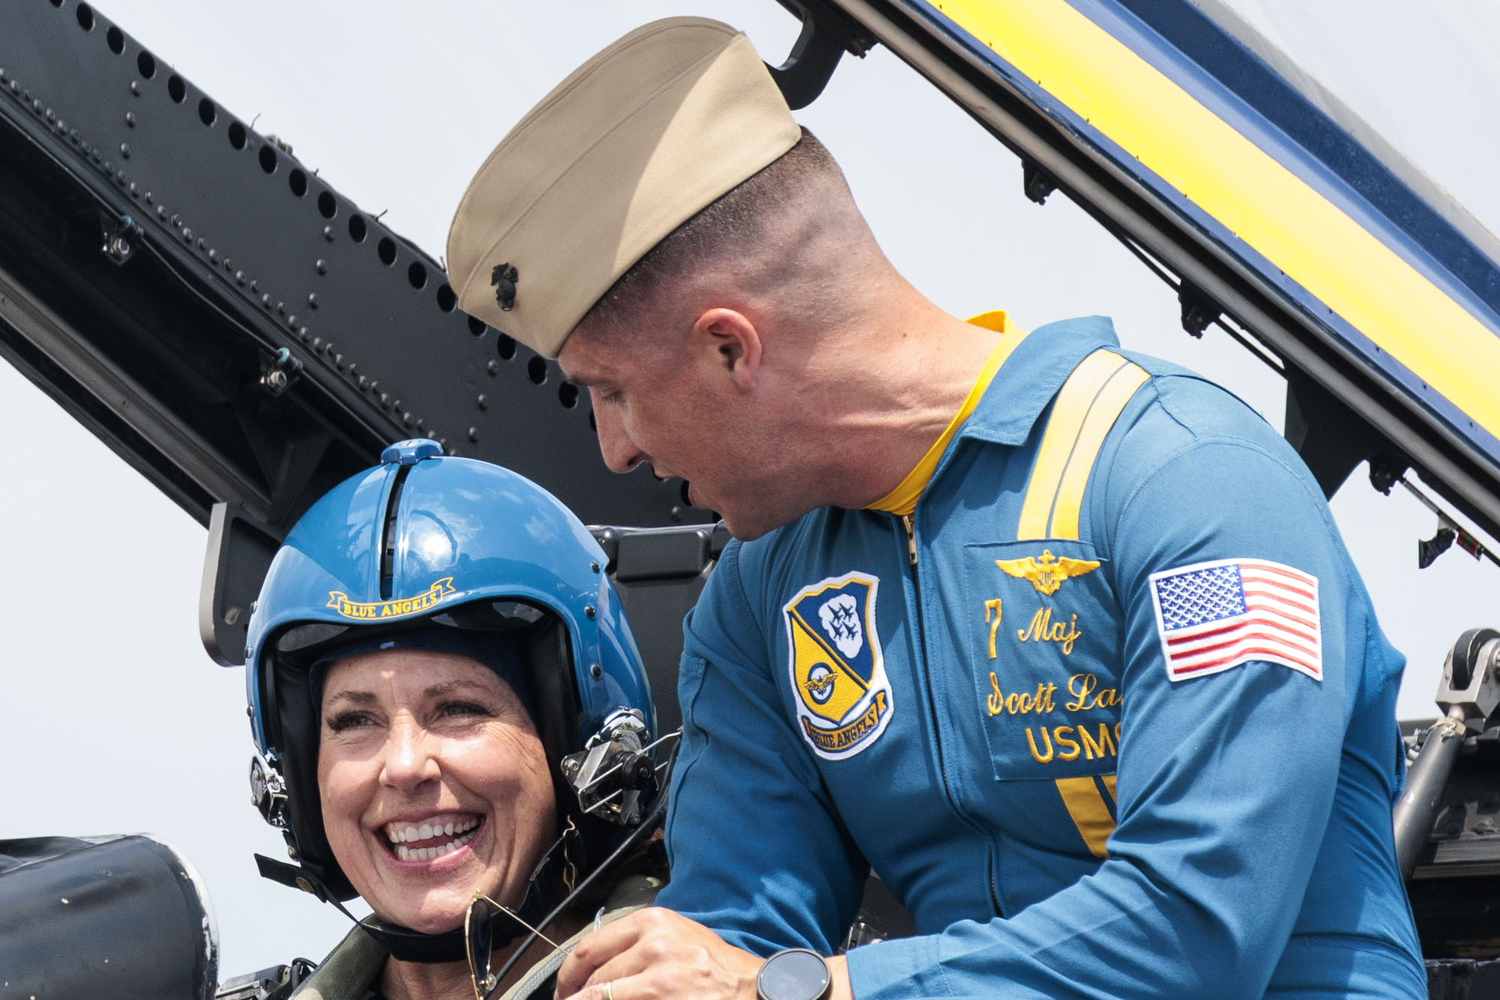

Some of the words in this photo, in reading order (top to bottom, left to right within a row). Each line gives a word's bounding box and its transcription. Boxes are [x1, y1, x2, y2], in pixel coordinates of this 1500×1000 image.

[343, 602, 376, 617] BLUE
[380, 593, 437, 617] ANGELS
[984, 598, 1002, 659] 7
[1018, 607, 1081, 655] Maj
[987, 672, 1057, 716] Scott
[1065, 673, 1124, 711] La
[811, 726, 837, 748] BLUE
[836, 710, 875, 748] ANGELS
[1025, 723, 1121, 764] USM
